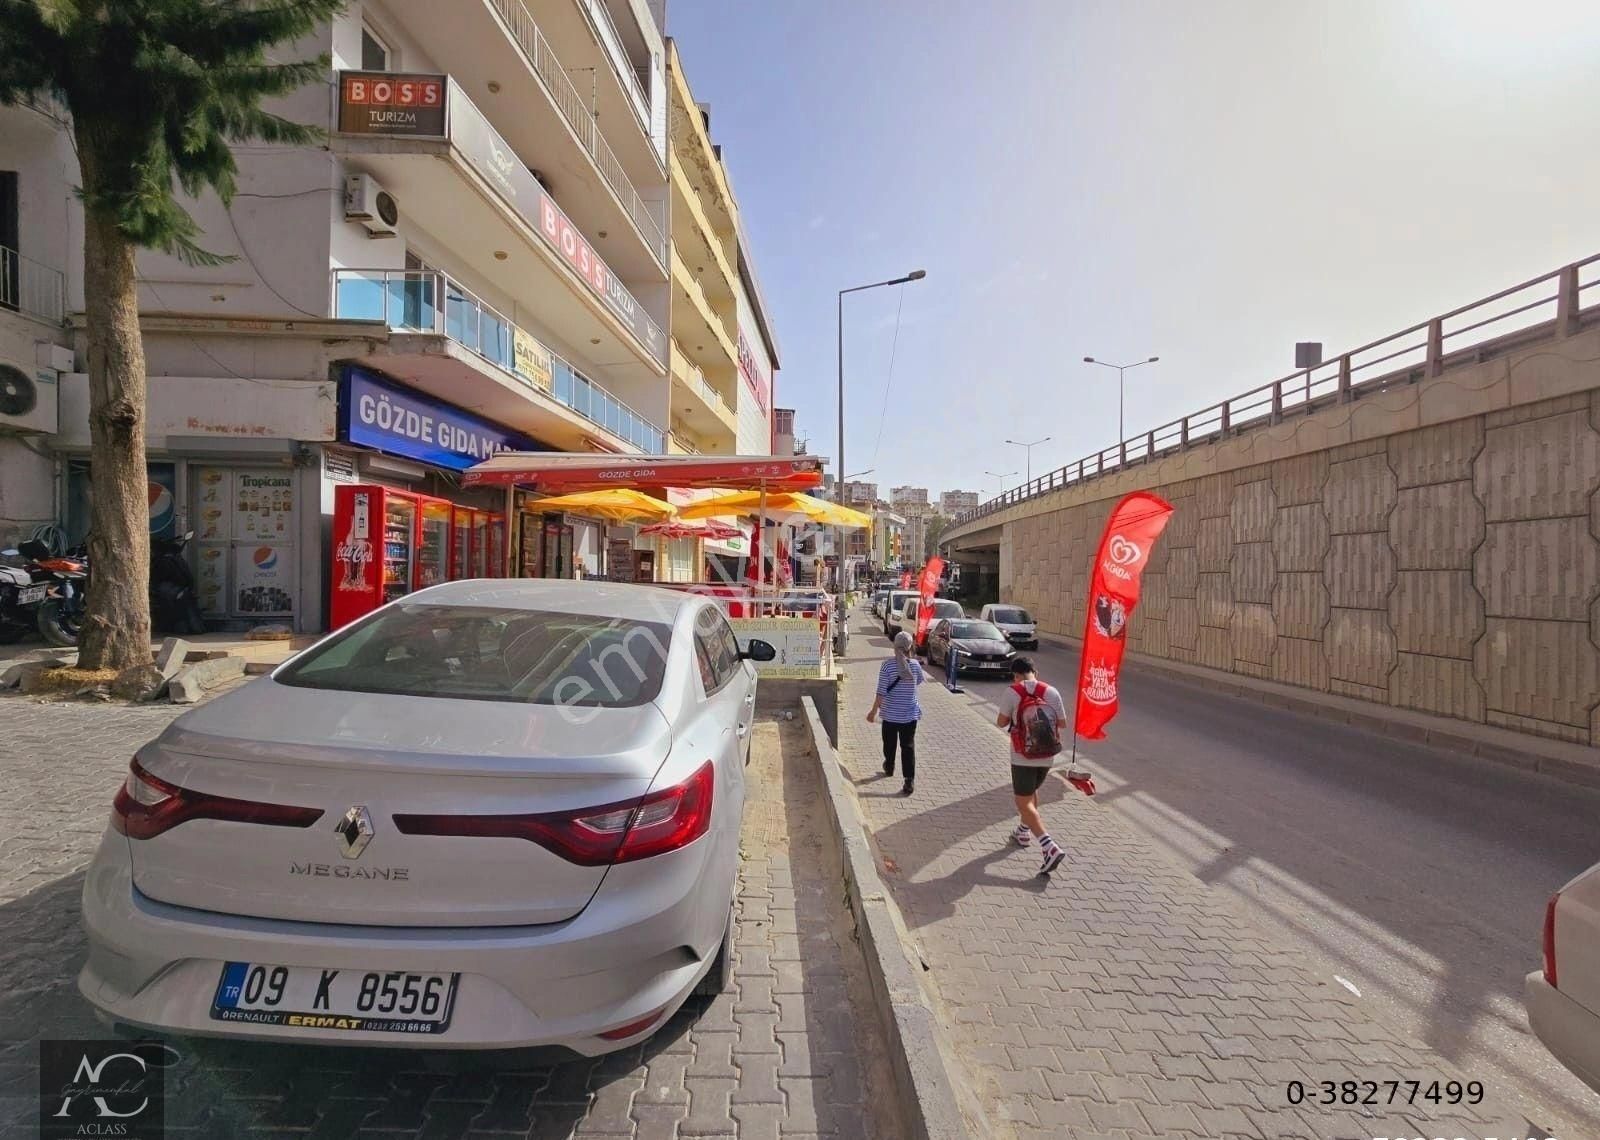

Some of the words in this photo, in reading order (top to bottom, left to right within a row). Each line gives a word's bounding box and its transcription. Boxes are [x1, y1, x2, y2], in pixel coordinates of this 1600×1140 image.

[351, 82, 437, 103] BOSS
[544, 200, 603, 289] BOSS
[359, 393, 433, 443] GÖZDE
[437, 422, 479, 458] GIDA
[240, 475, 291, 488] Tropicana
[290, 862, 409, 881] MEGANE
[225, 986, 239, 998] TR
[244, 966, 289, 1006] 09
[313, 970, 339, 1010] K
[356, 973, 443, 1015] 8556
[230, 1011, 279, 1023] RENAULT
[289, 1015, 361, 1029] ERMAT
